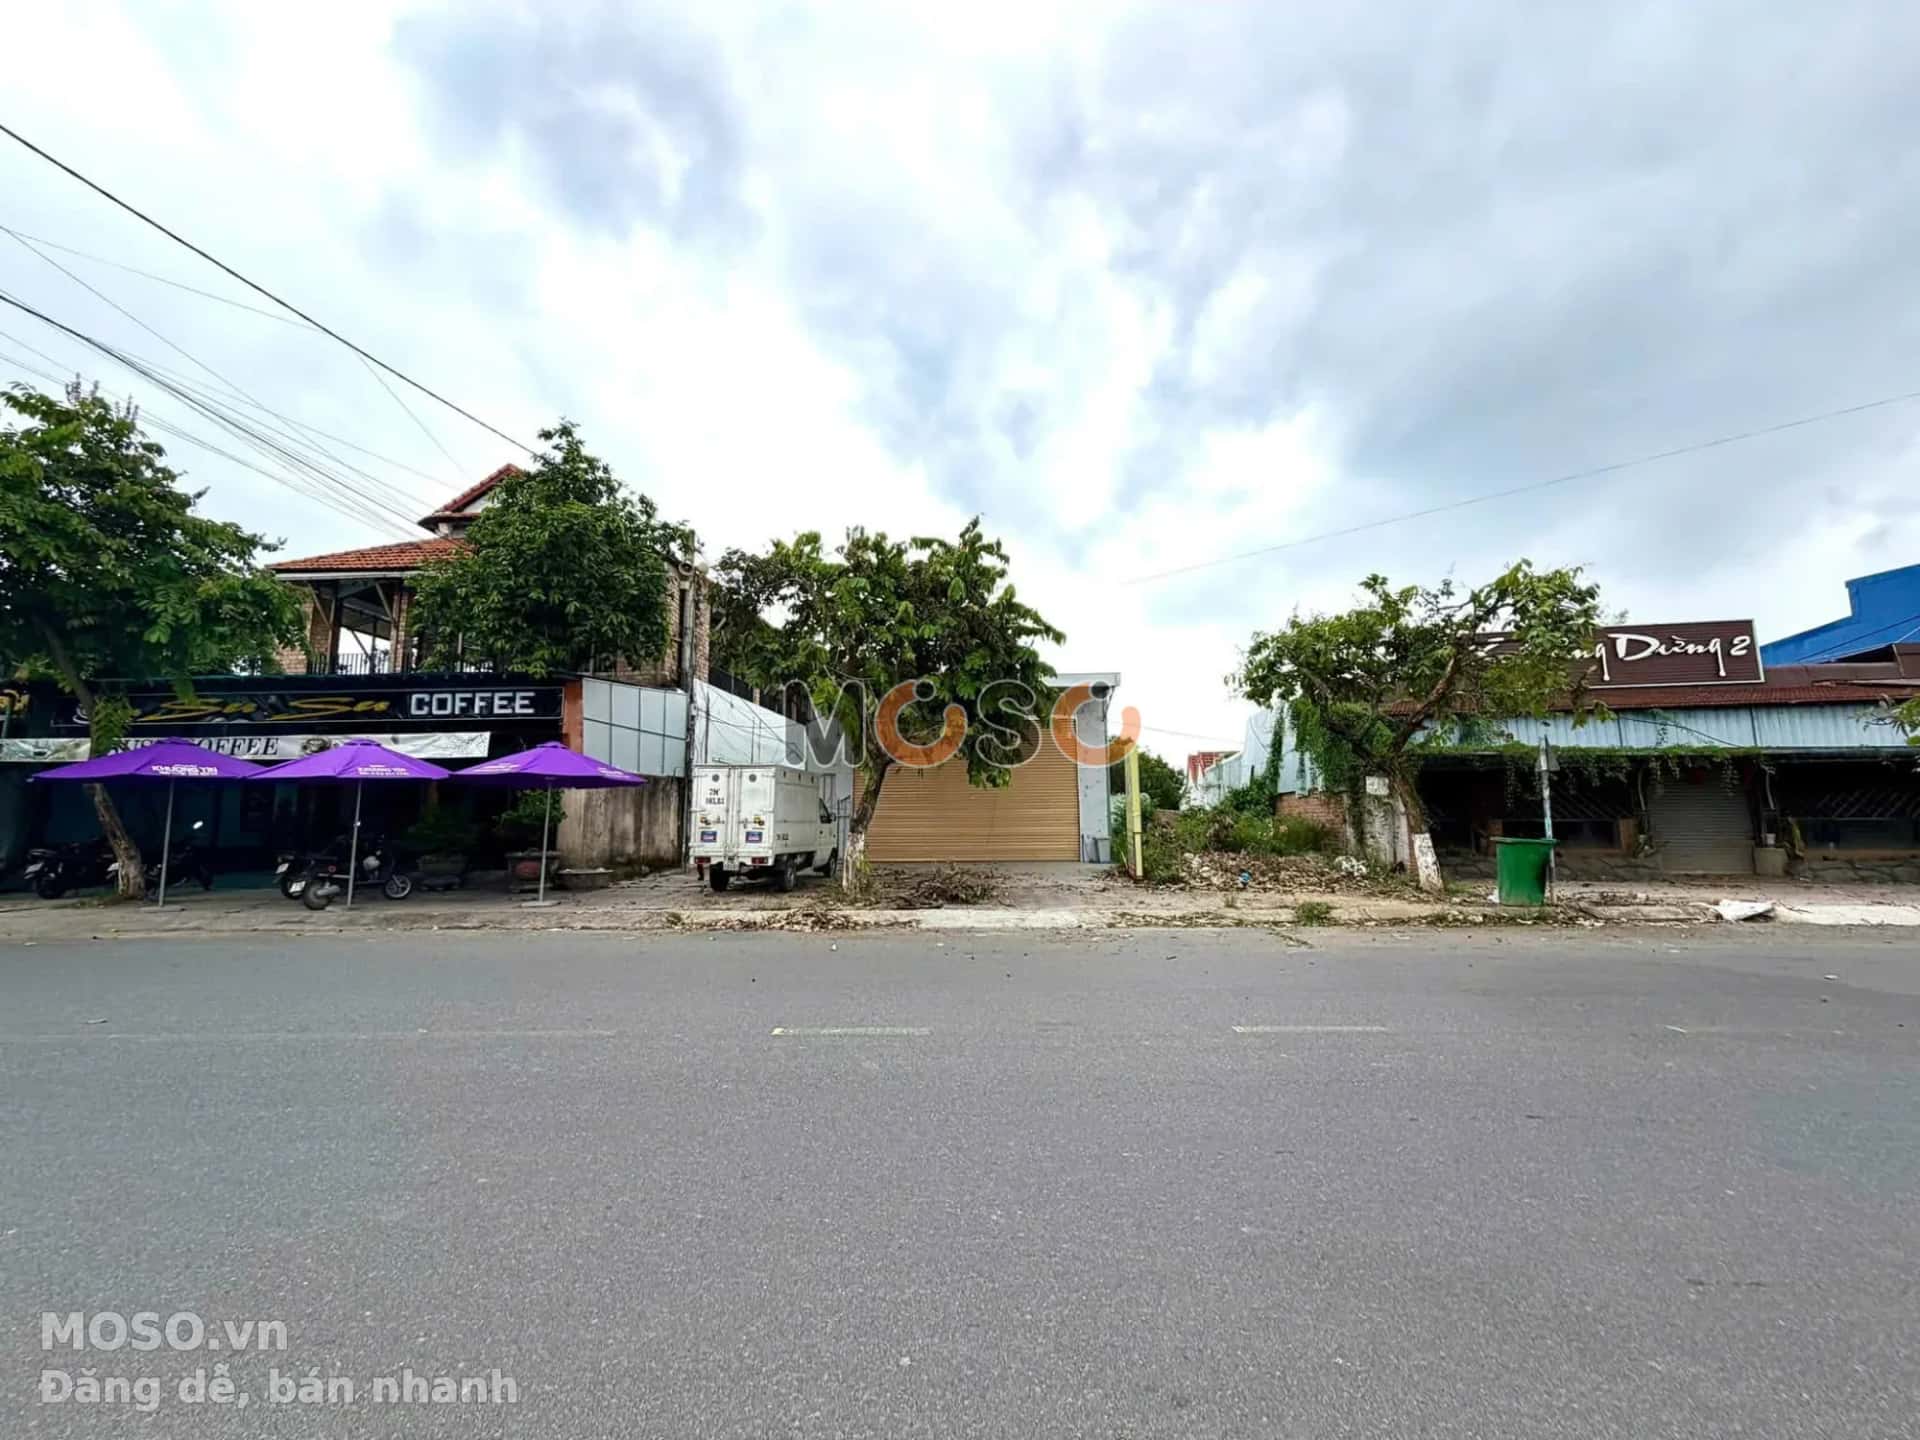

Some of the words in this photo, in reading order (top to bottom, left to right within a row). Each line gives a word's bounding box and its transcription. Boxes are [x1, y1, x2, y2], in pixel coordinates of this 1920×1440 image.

[1729, 635, 1751, 656] 2
[409, 691, 536, 716] COFFEE
[195, 737, 280, 756] OFFEE
